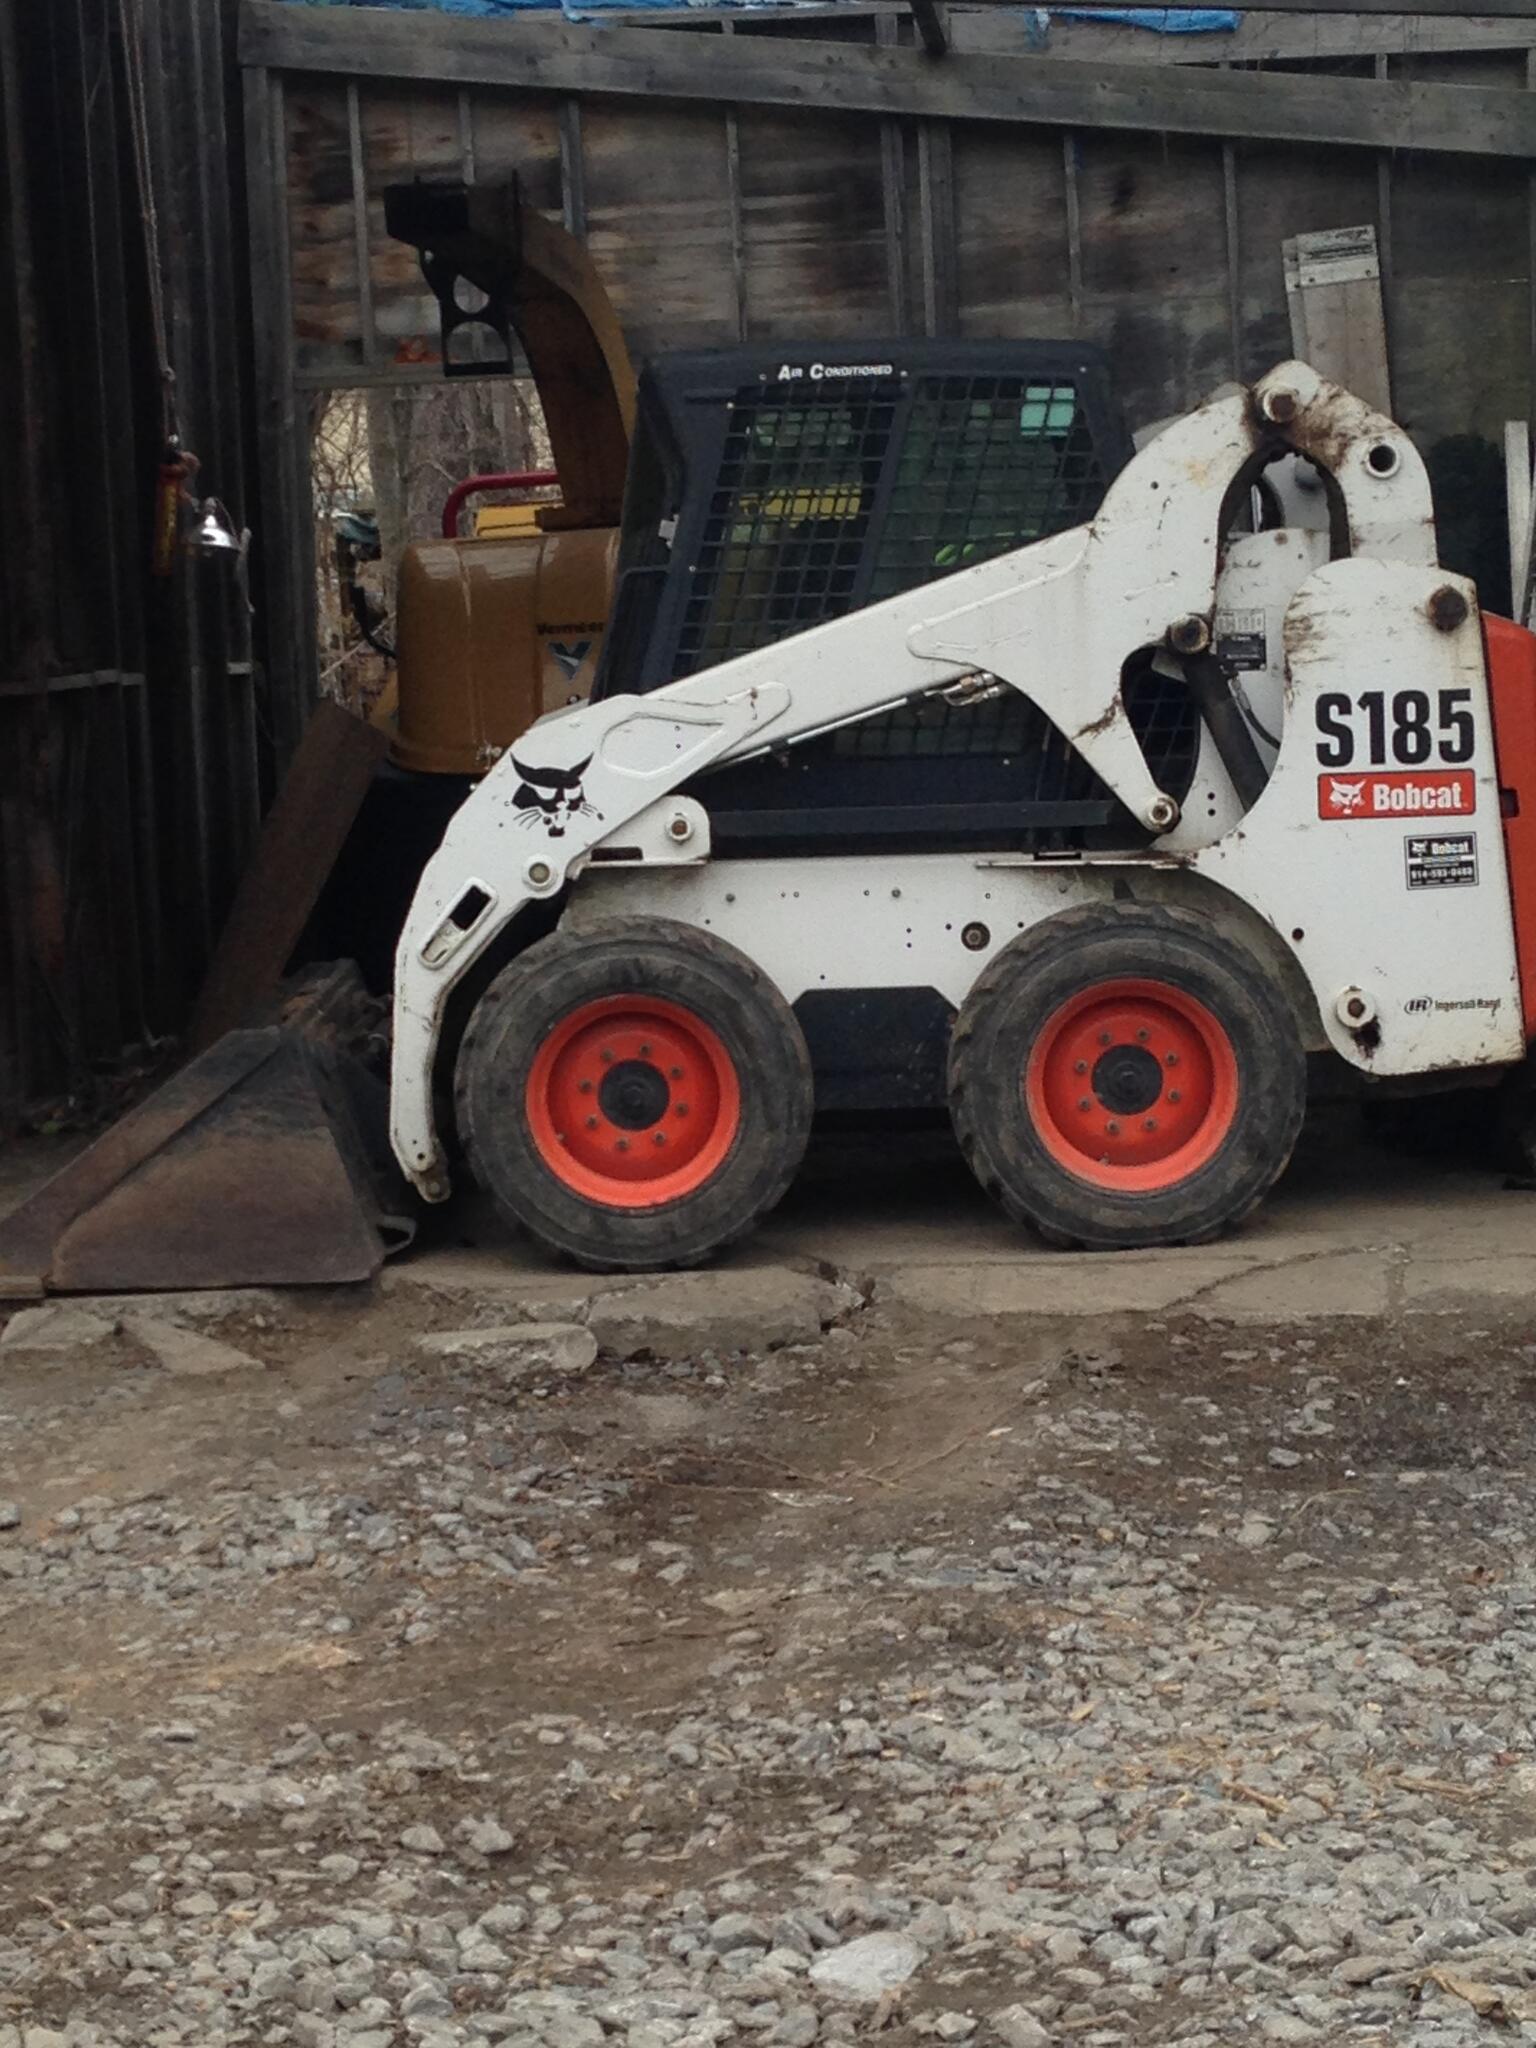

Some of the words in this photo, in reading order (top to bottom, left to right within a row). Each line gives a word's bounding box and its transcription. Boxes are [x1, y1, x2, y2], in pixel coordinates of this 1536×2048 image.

[1315, 688, 1475, 767] S185
[1373, 782, 1463, 811] Bobcat
[1431, 841, 1469, 855] Bobcat
